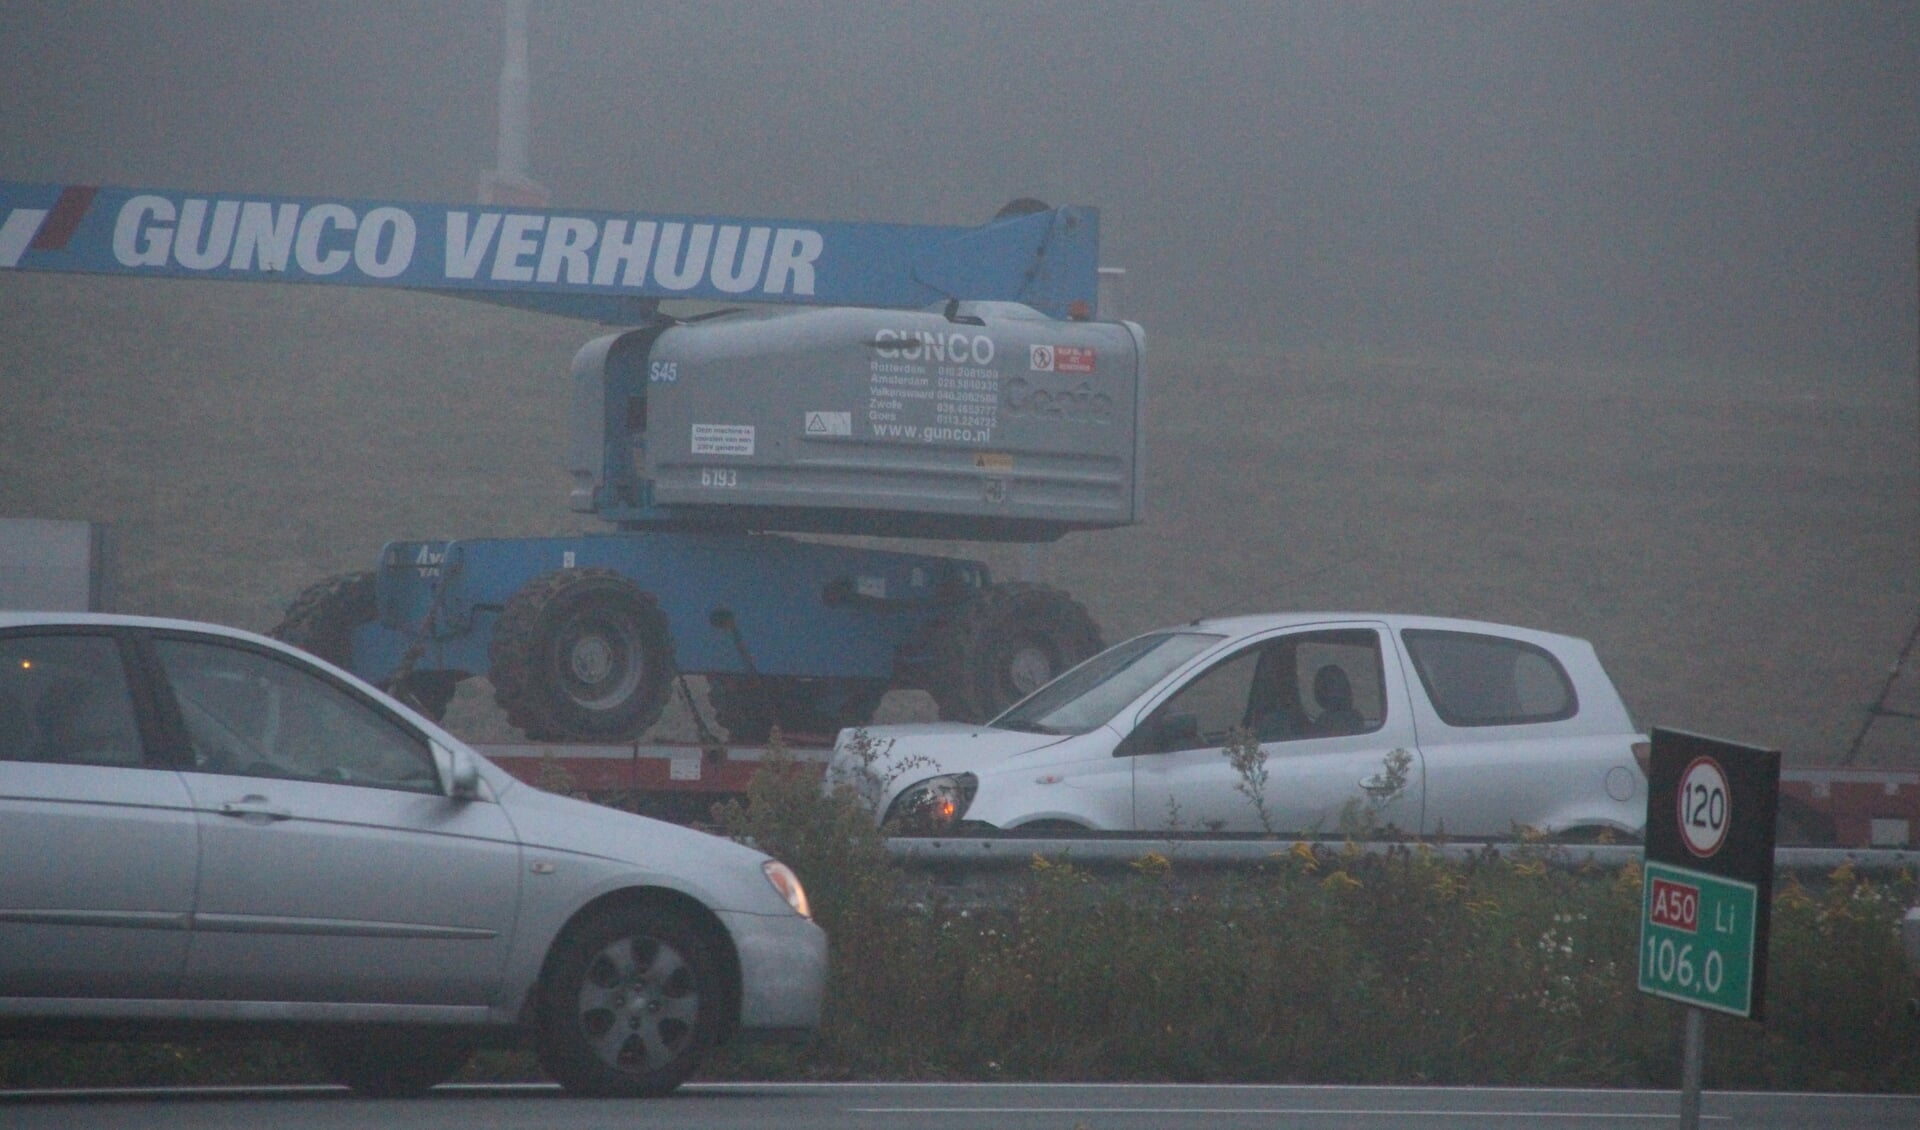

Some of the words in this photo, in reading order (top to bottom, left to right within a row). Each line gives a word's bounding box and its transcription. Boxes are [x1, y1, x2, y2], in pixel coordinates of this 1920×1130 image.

[112, 194, 417, 279] GUNCO
[444, 210, 824, 296] VERHUUR
[875, 329, 995, 365] GUNCO
[650, 361, 678, 382] S45
[870, 361, 926, 374] Rotterdam
[870, 373, 929, 386] Amsterdam
[869, 398, 903, 410] Zwolle
[869, 410, 897, 421] Goes
[873, 423, 991, 442] www.gunco.nl
[701, 467, 737, 487] 6193
[1685, 782, 1725, 829] 120
[1654, 887, 1696, 924] A50
[1714, 900, 1735, 935] Li
[1647, 935, 1723, 993] 106,0
